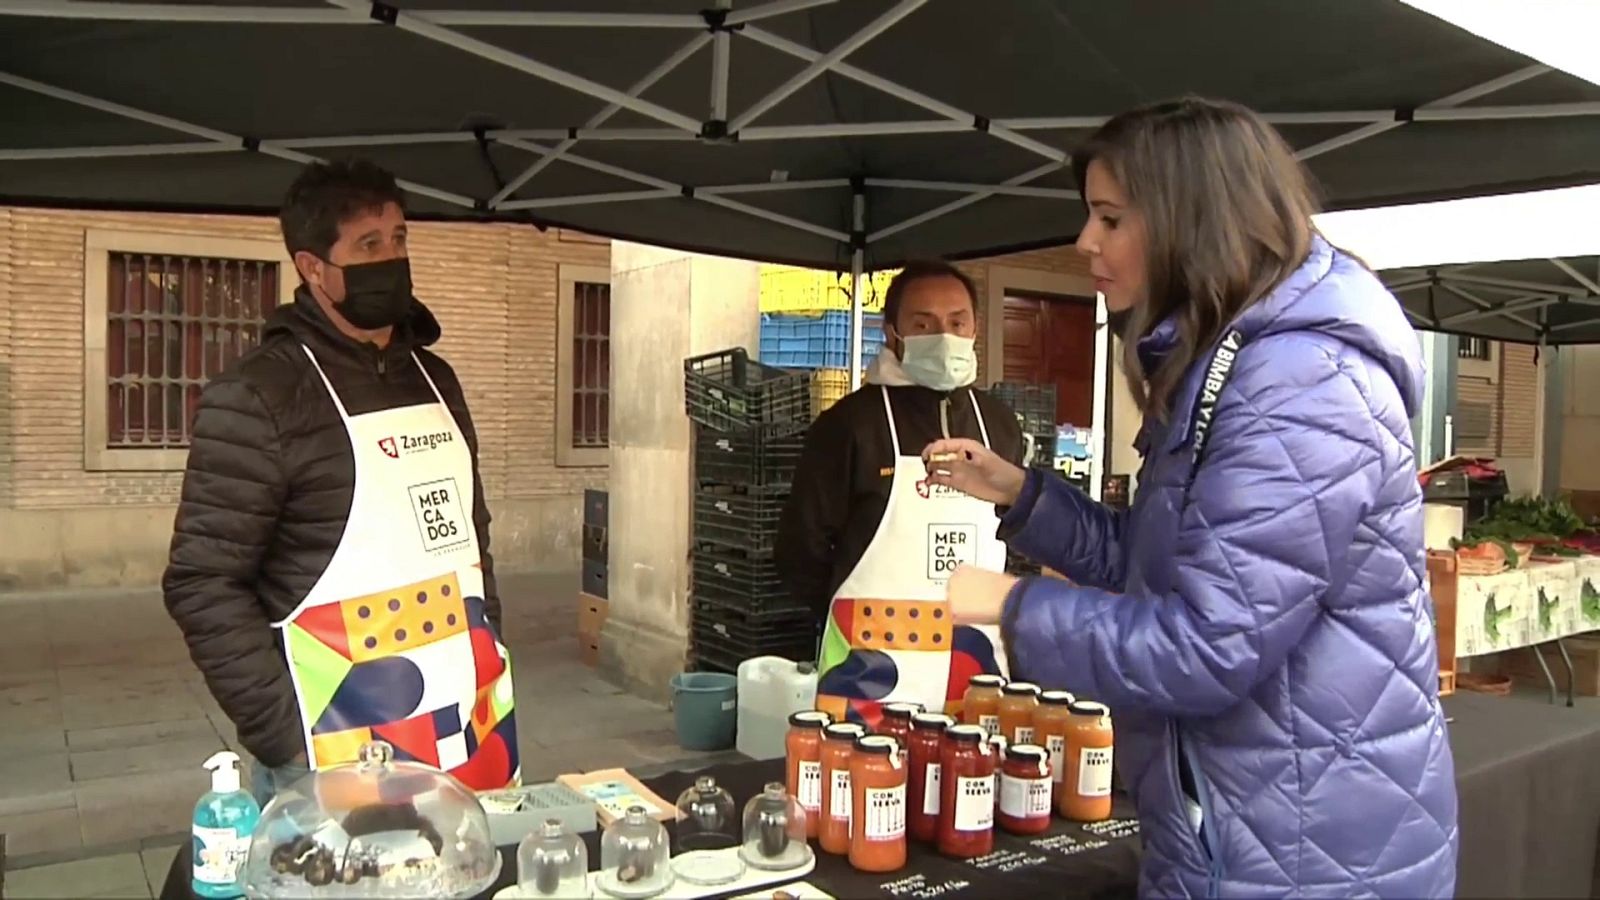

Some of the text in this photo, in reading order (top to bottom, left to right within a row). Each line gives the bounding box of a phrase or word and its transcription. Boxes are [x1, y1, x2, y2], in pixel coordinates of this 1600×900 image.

[400, 431, 453, 449] Zaragoza
[418, 488, 450, 508] MER
[423, 508, 445, 524] CA
[427, 520, 457, 541] DOS
[934, 531, 967, 545] MER
[934, 545, 956, 558] CA
[872, 791, 894, 800] CON
